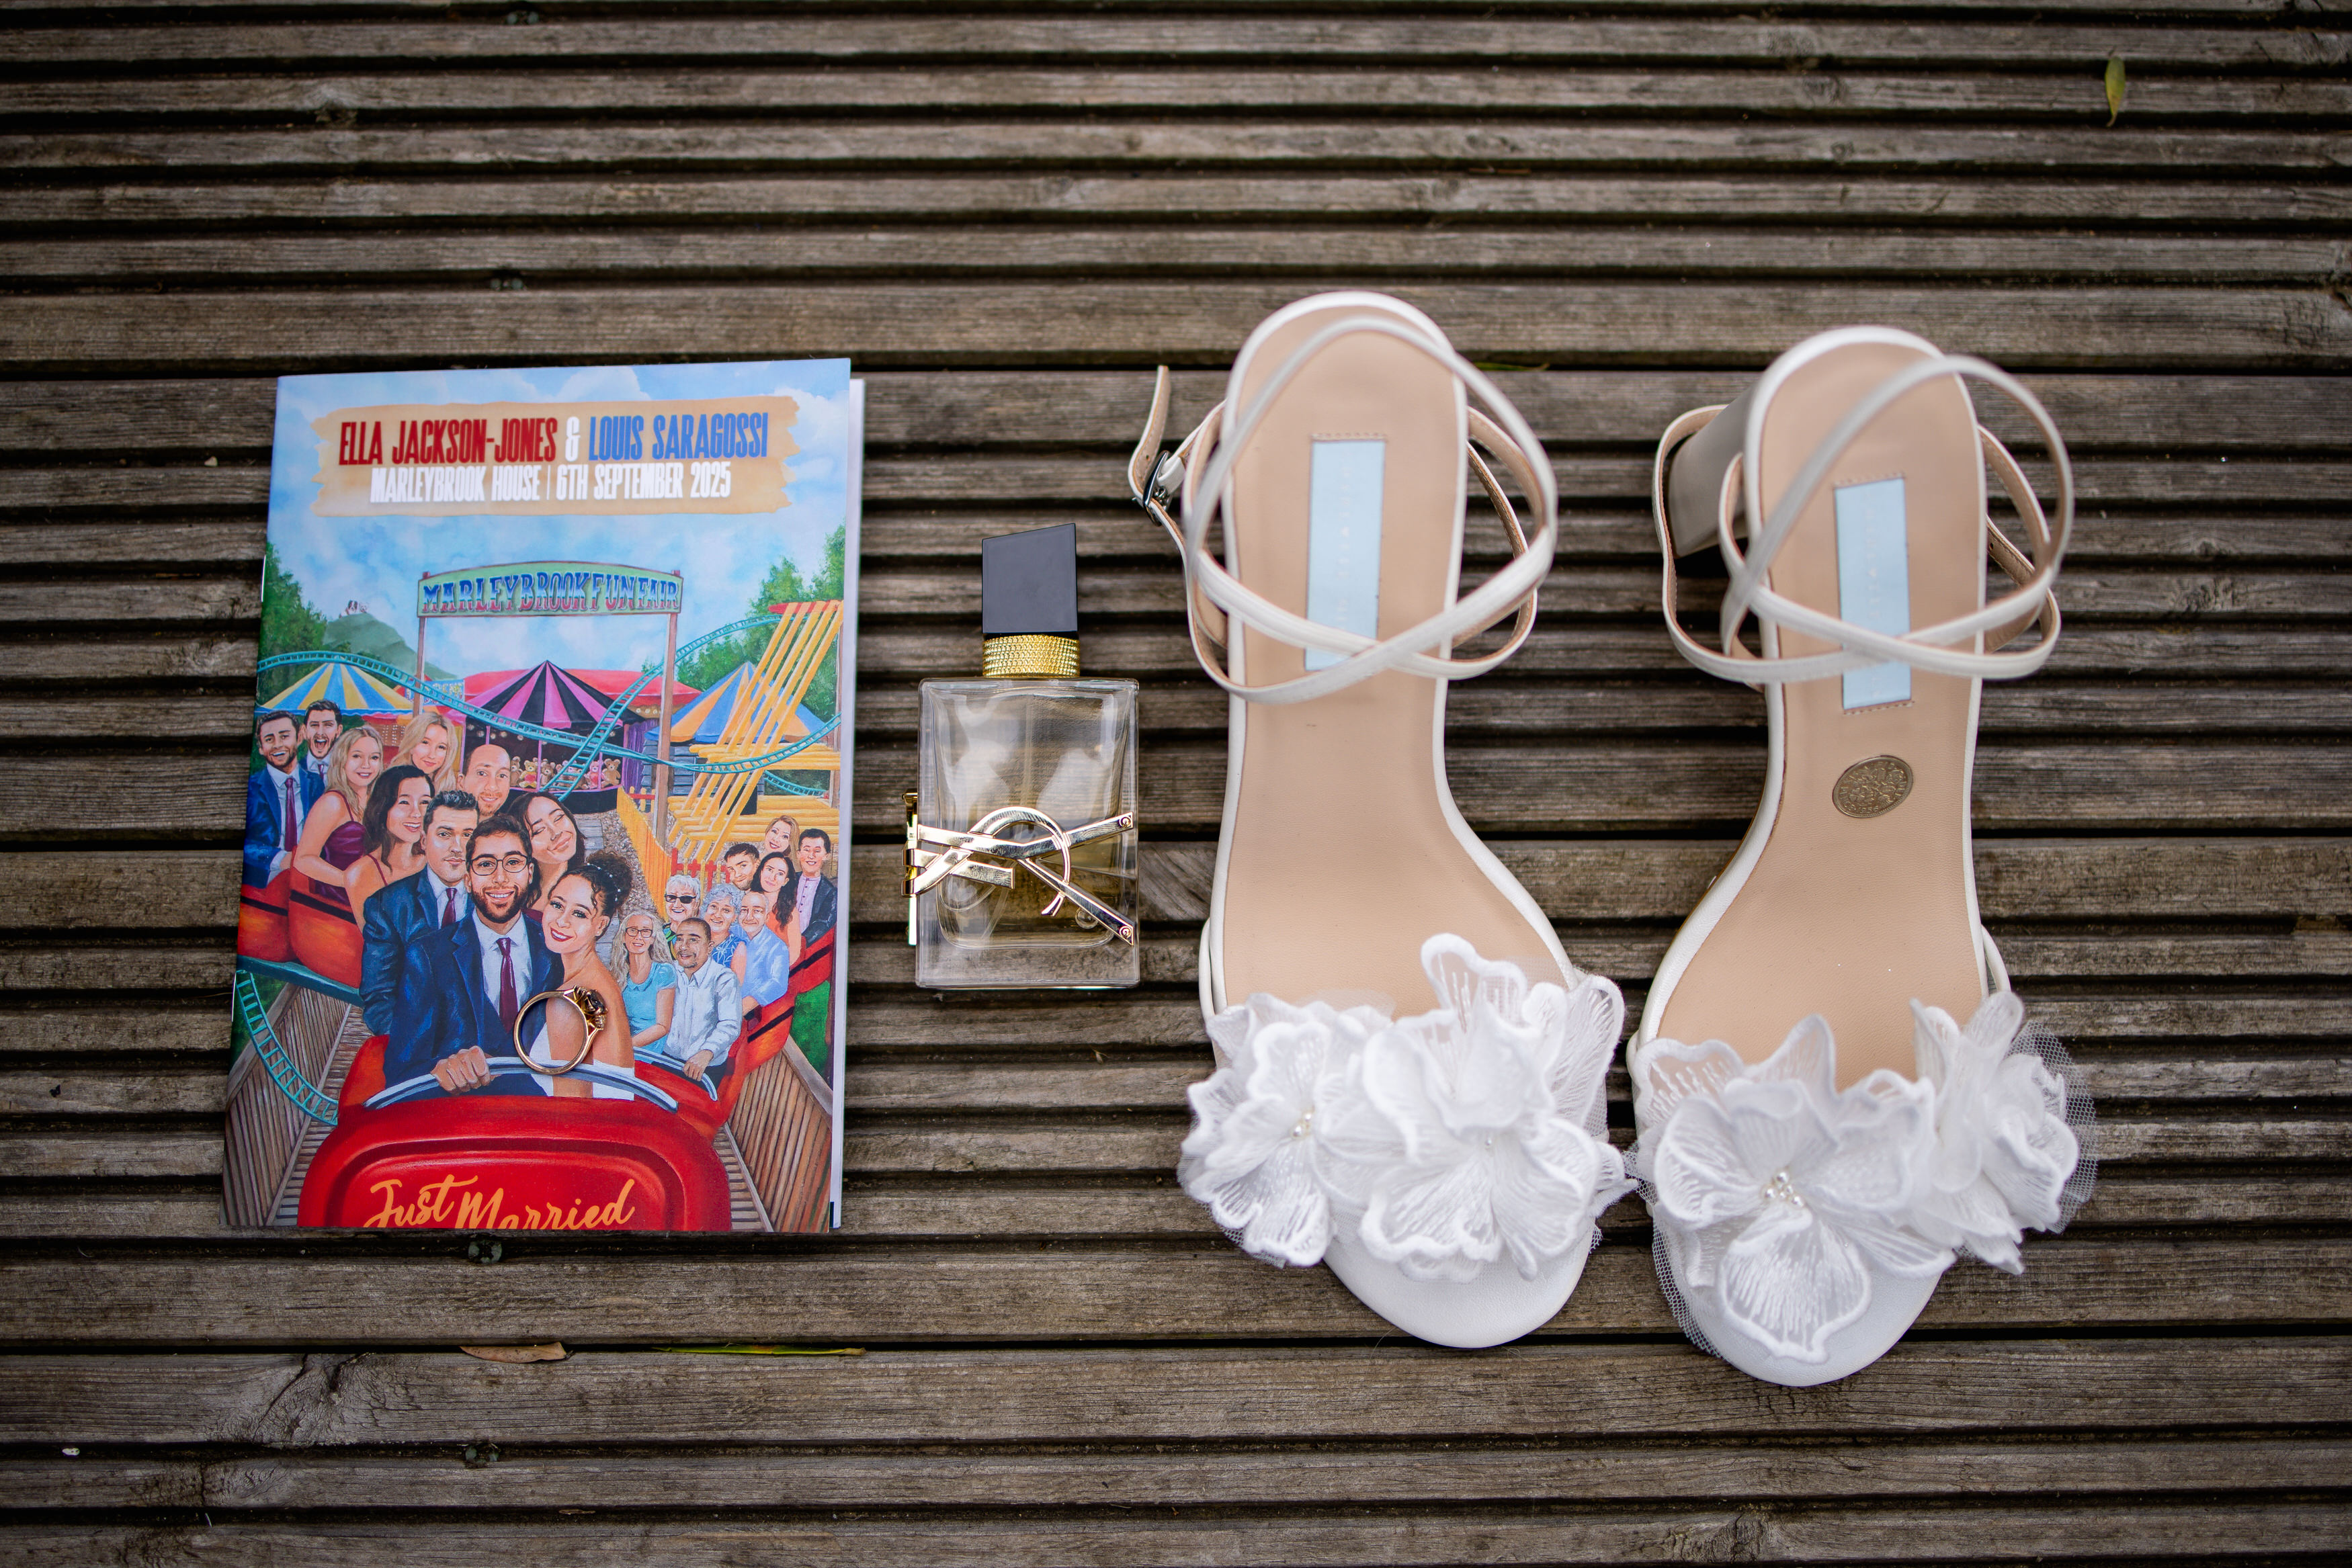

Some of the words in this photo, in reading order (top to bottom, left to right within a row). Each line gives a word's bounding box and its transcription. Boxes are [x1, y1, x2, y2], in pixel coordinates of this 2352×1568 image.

[339, 421, 382, 465] ELLA
[392, 418, 558, 464] JACKSON-JONES
[565, 417, 581, 462] &
[589, 415, 644, 461] LOUIS
[652, 412, 768, 460] SARAGOSSI
[370, 466, 487, 503] MARLEYBROOK
[491, 465, 542, 501] HOUSE
[556, 464, 589, 500] 6TH
[593, 462, 684, 499] SEPTEMBER
[689, 461, 731, 498] 2025
[363, 1174, 478, 1228] Just
[455, 1179, 635, 1230] Married
